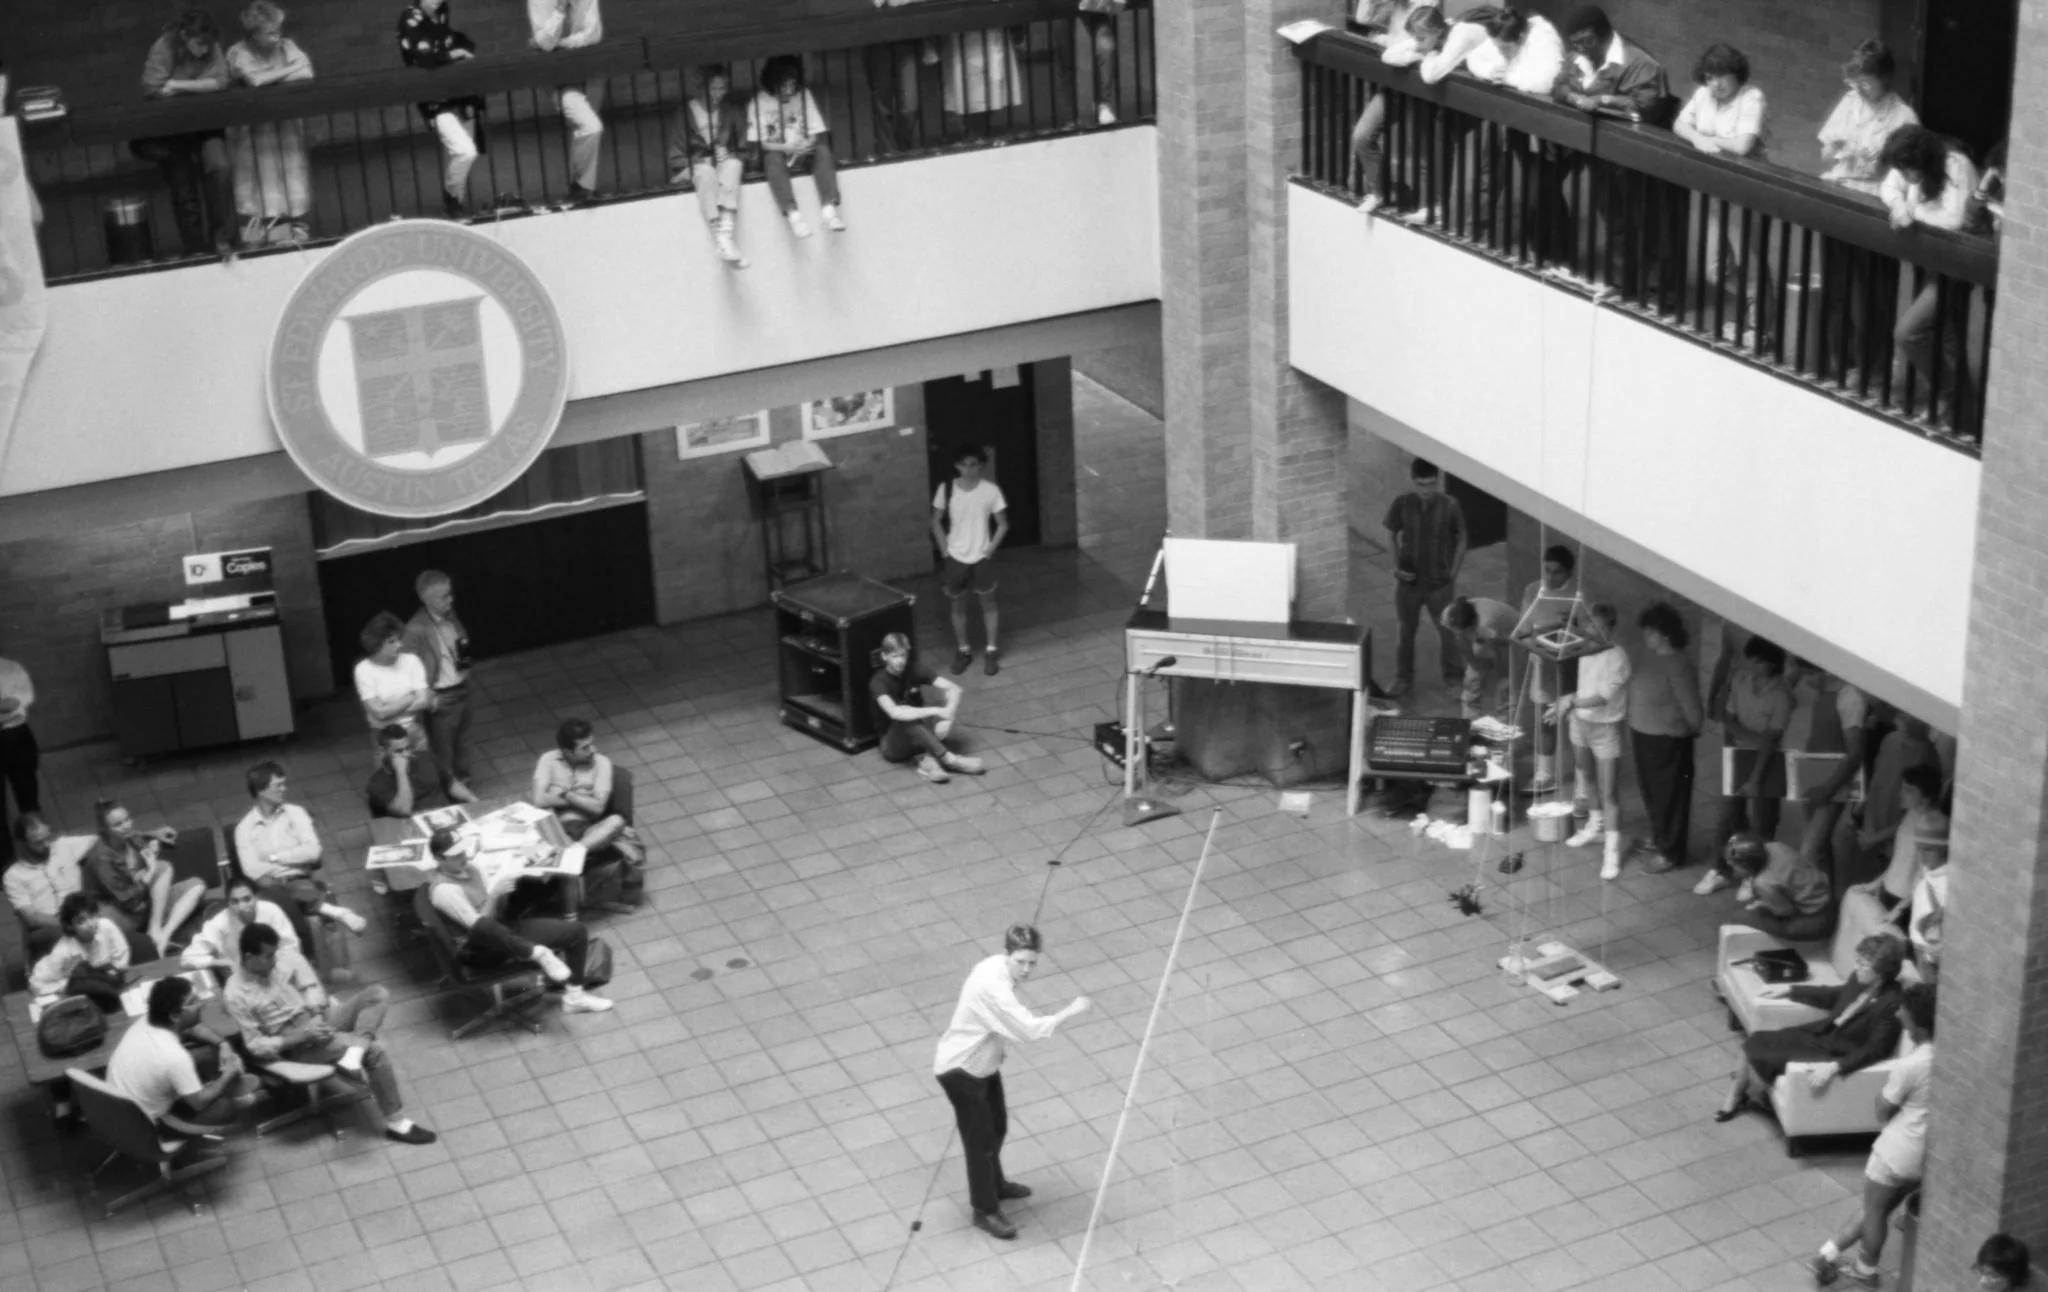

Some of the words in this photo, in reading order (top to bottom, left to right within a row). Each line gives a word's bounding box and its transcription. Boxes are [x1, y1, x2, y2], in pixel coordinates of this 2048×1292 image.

[419, 233, 557, 371] UNIVERSITY
[317, 453, 435, 506] AUSTIN
[448, 417, 538, 495] TEXAS
